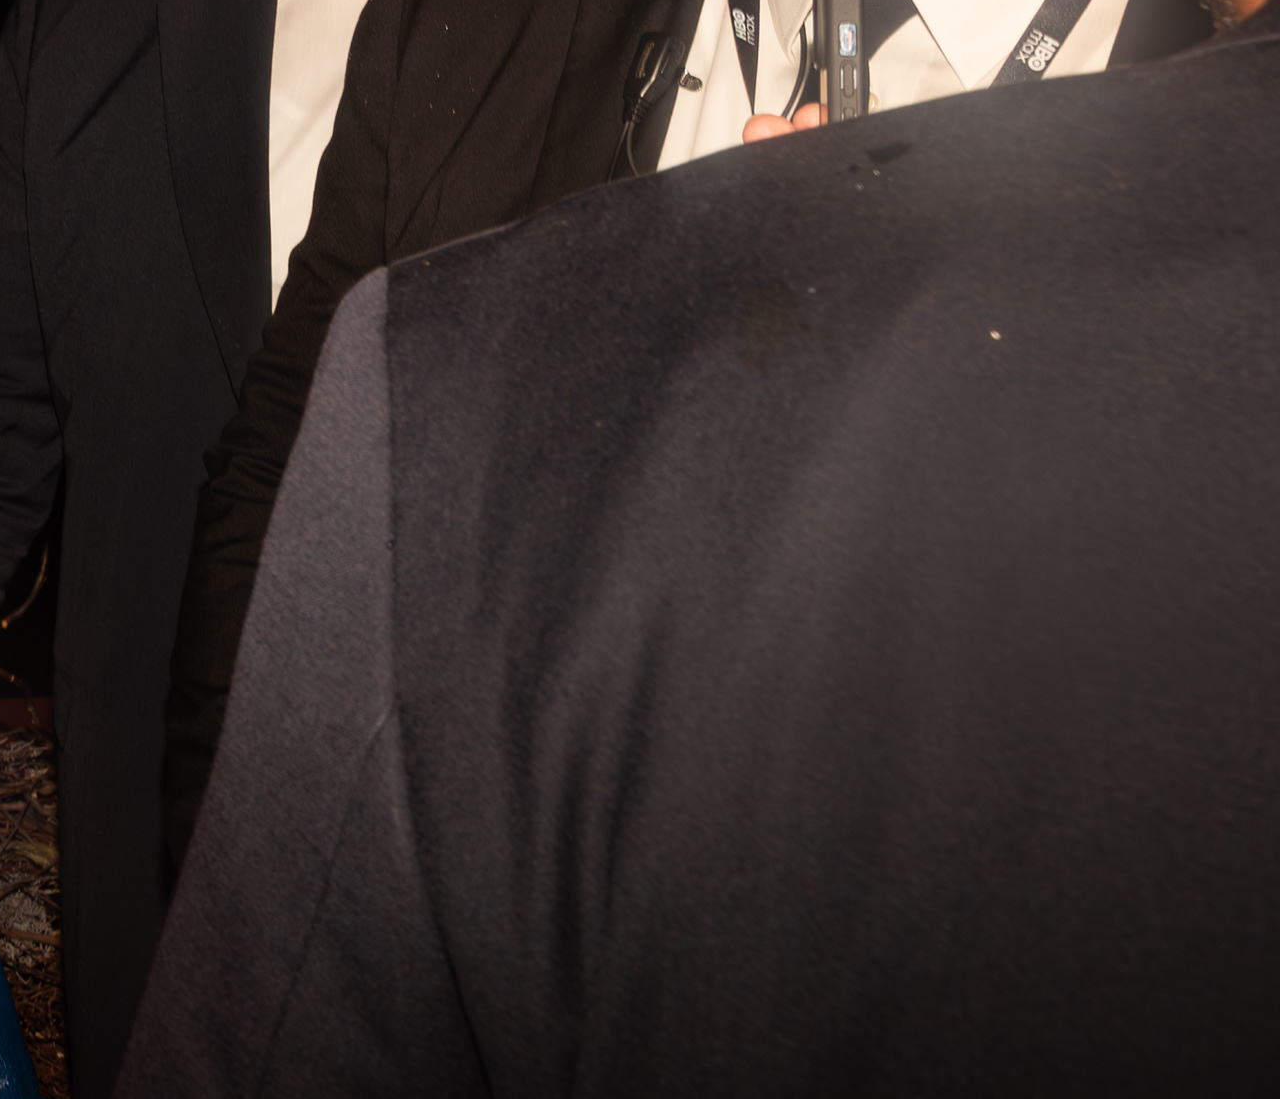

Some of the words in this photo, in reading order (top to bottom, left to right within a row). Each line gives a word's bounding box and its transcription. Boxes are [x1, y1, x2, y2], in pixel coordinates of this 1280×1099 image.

[731, 7, 747, 42] HBO
[745, 12, 756, 46] max
[1015, 28, 1043, 65] max
[1027, 33, 1060, 72] HBO
